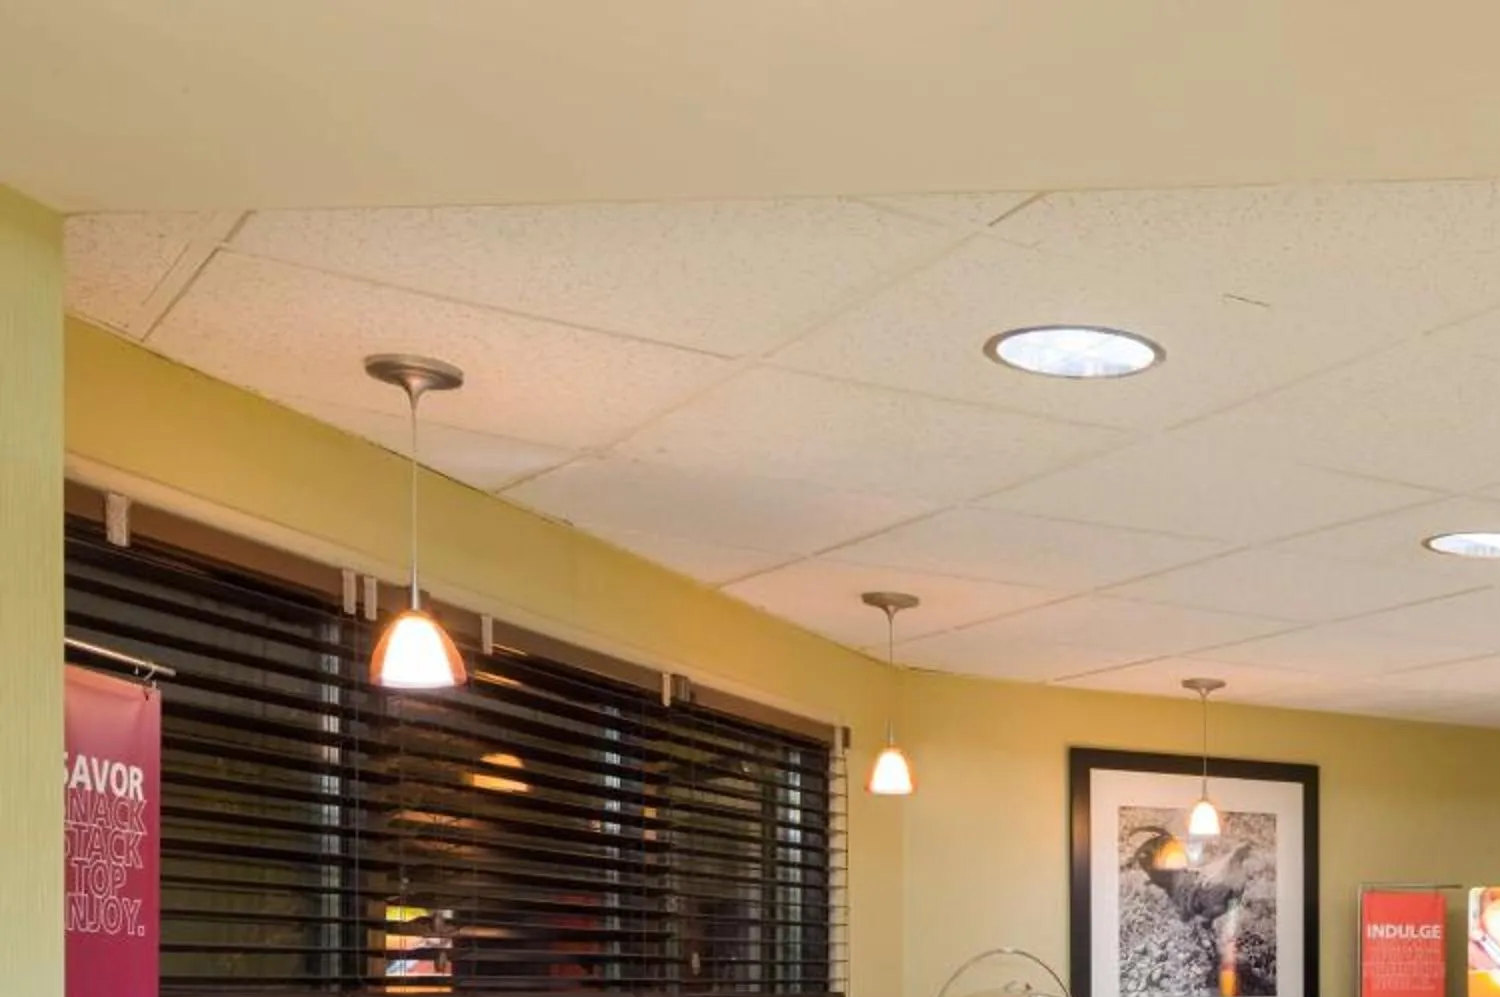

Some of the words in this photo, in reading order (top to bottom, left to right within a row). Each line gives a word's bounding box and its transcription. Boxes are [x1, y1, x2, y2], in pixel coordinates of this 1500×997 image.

[65, 787, 147, 835] NACK
[71, 857, 127, 898] TOP
[65, 893, 146, 936] NJOY.
[1367, 923, 1441, 940] INDULGE
